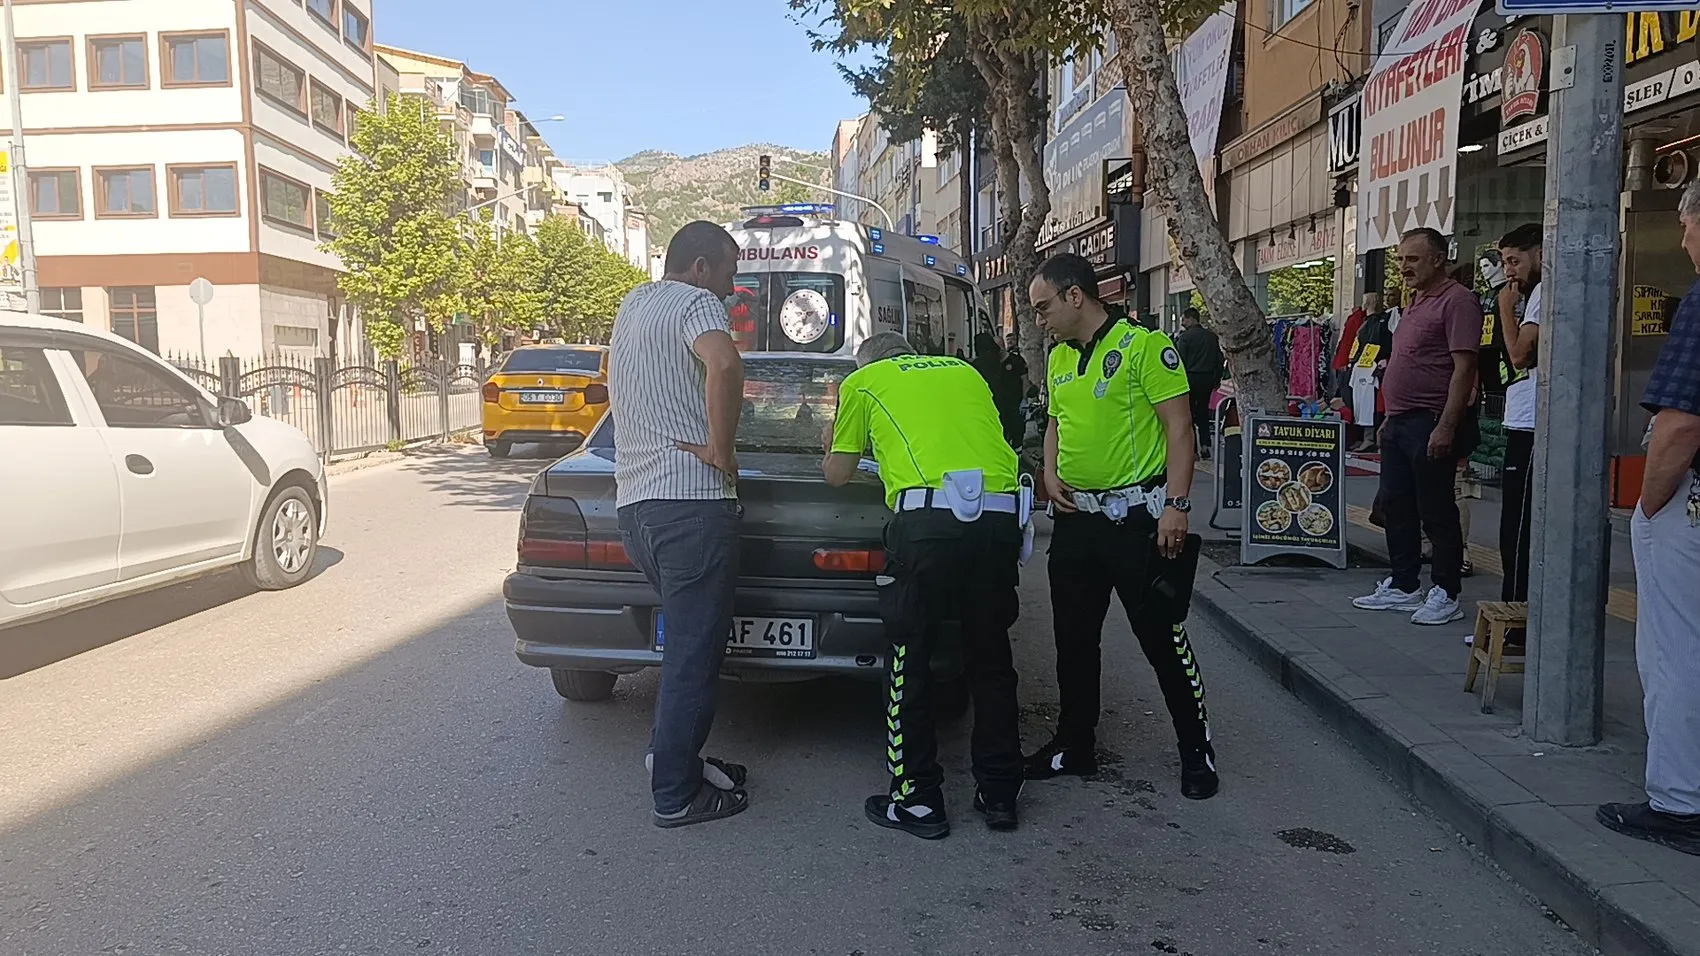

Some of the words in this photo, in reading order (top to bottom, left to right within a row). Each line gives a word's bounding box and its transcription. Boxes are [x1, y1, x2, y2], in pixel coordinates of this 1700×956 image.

[1626, 82, 1663, 109] ŞLER
[1327, 98, 1358, 172] MU
[1370, 107, 1445, 182] BULUNUR
[737, 246, 818, 261] MBULANS
[1273, 426, 1302, 437] TAVUK
[763, 621, 806, 646] 461
